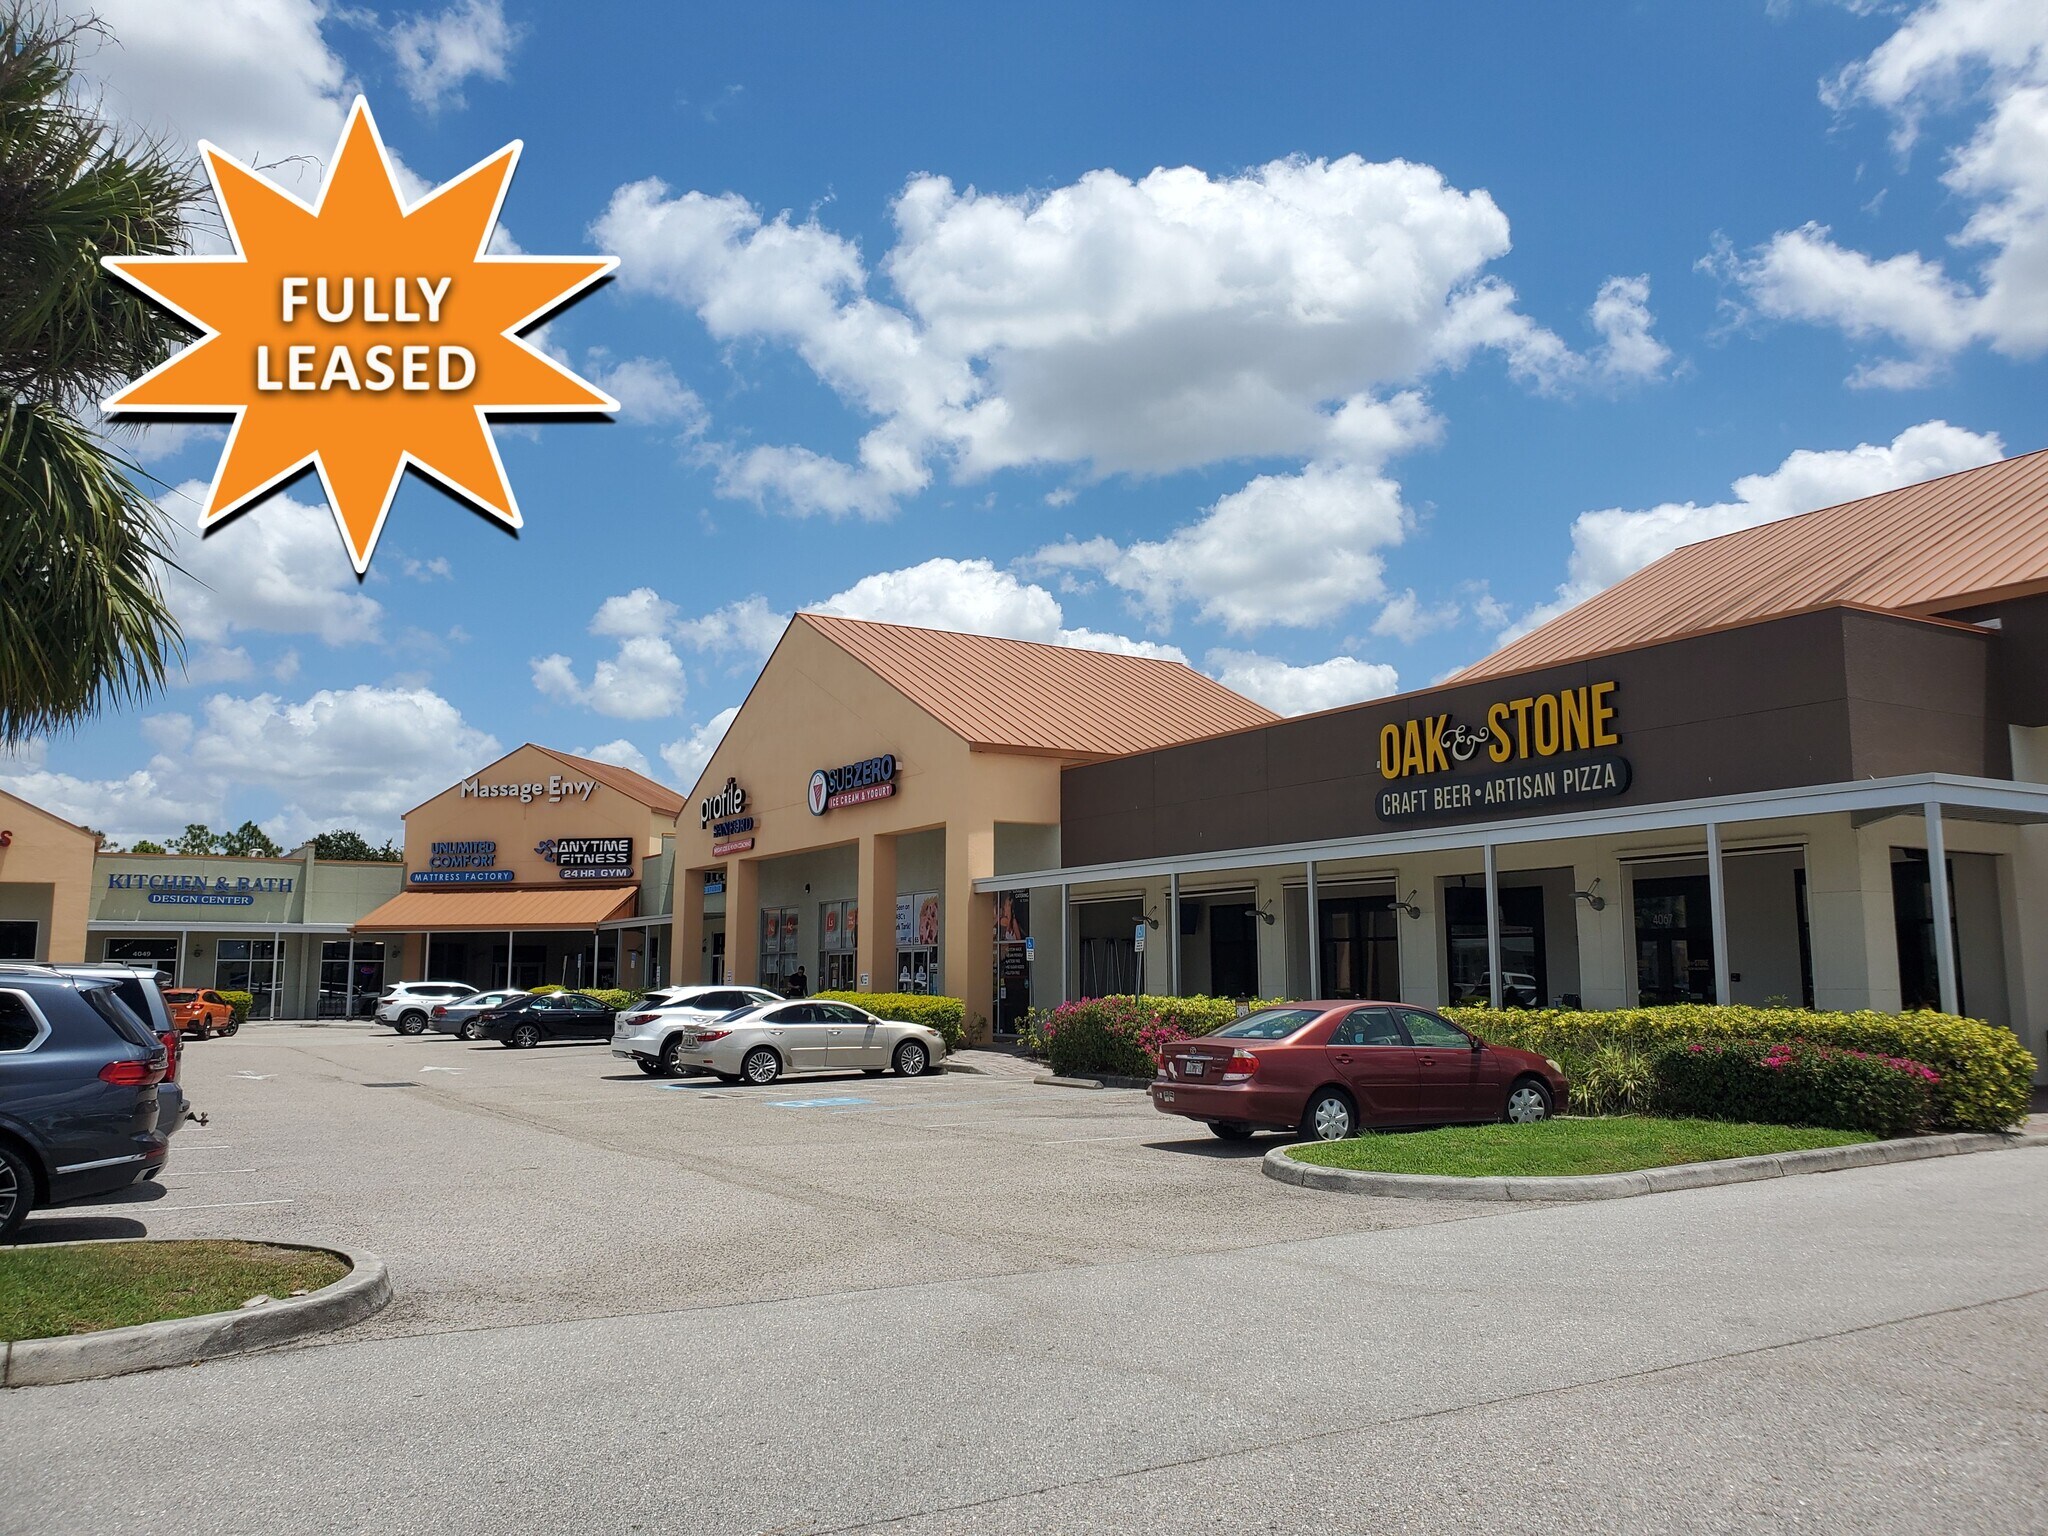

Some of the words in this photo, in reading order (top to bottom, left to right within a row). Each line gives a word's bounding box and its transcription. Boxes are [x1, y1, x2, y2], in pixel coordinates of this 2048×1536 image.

[1380, 713, 1450, 780] OAK
[1441, 725, 1489, 761] &
[1487, 681, 1619, 763] STONE
[827, 754, 895, 793] SUBZERO
[460, 778, 543, 803] Massage
[549, 775, 596, 803] Envy
[830, 796, 839, 807] ICE
[840, 795, 860, 806] CREAM
[861, 791, 866, 801] &
[866, 785, 890, 799] YOGURT
[1382, 789, 1428, 816] CRAFT
[1434, 784, 1472, 810] BEER
[1484, 771, 1556, 804] ARTISAN
[1563, 763, 1616, 794] PIZZA
[701, 777, 745, 829] profile
[431, 841, 496, 854] UNLIMITED
[558, 840, 629, 853] ANYTIME
[429, 854, 496, 868] COMFORT
[414, 873, 460, 882] MATTRESS
[465, 872, 509, 881] FACTORY
[564, 869, 578, 878] 24
[580, 869, 595, 877] HR
[600, 868, 627, 877] GYM
[108, 873, 209, 892] KITCHEN
[214, 876, 231, 892] &
[236, 876, 294, 893] BATH
[152, 894, 199, 904] DESIGN
[201, 895, 250, 905] CENTER
[1653, 913, 1673, 926] 4067
